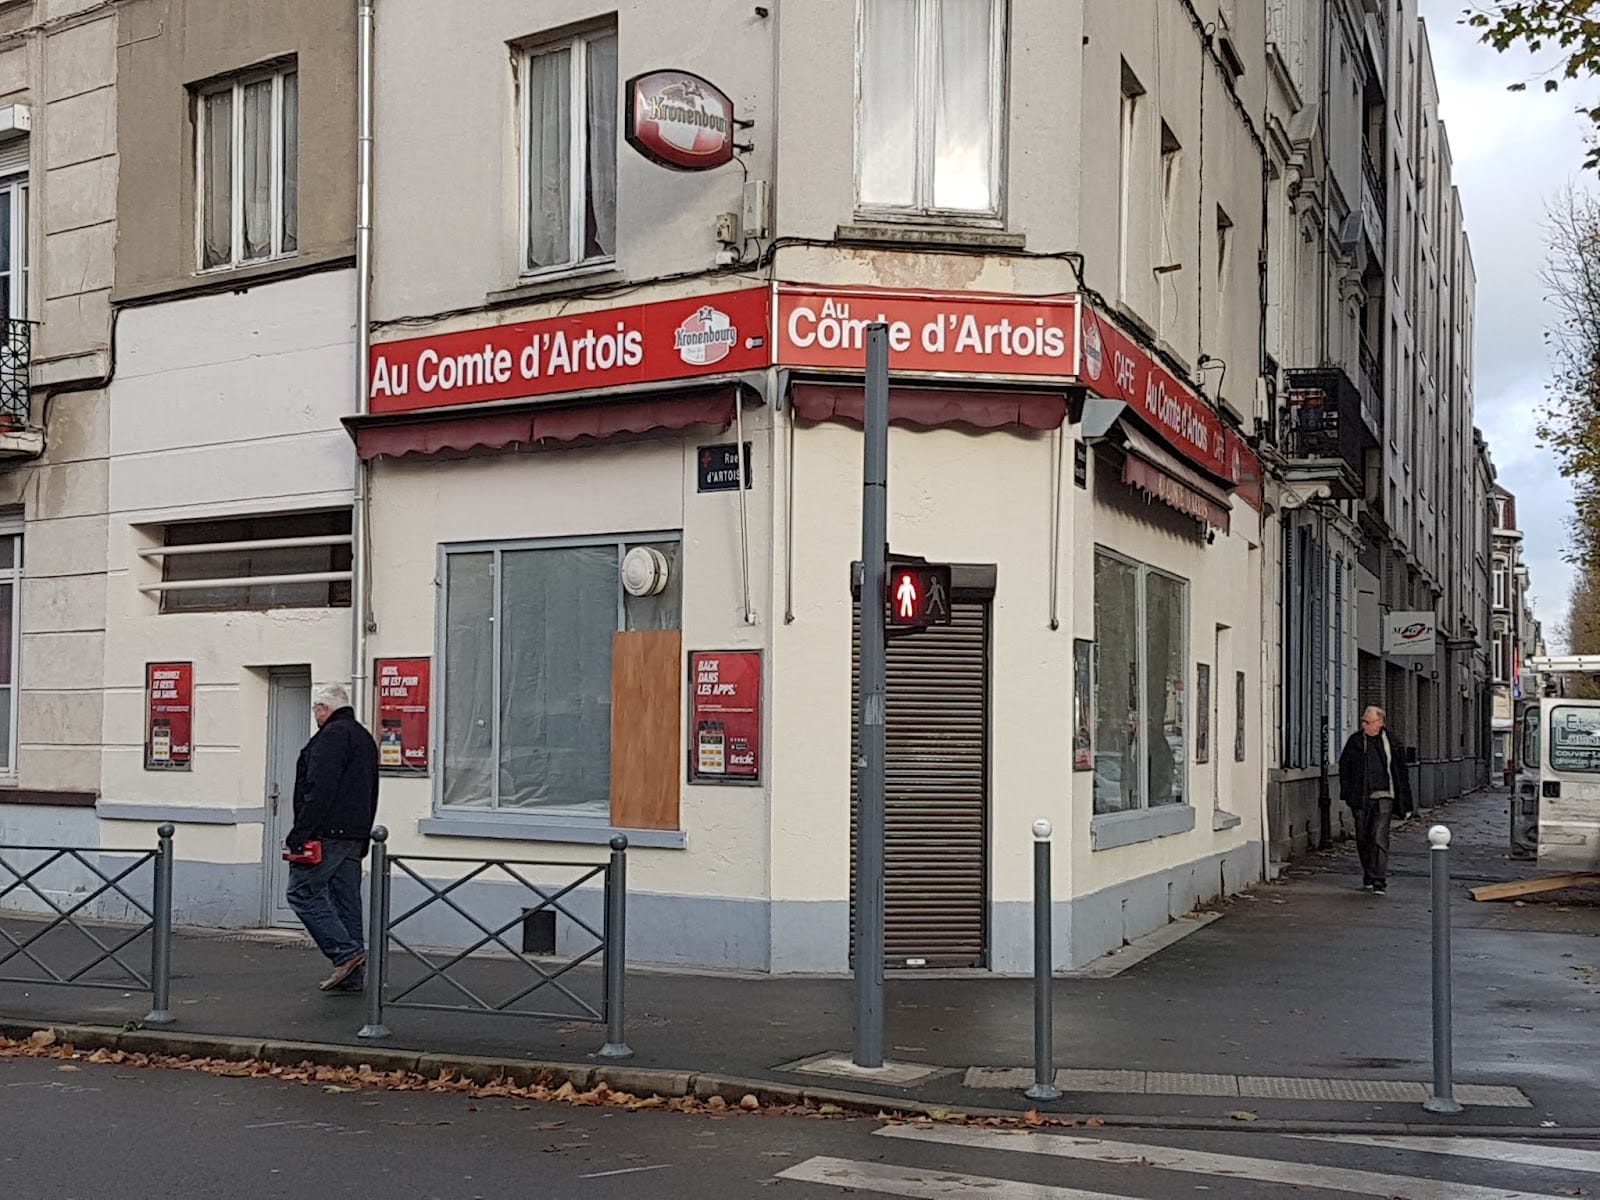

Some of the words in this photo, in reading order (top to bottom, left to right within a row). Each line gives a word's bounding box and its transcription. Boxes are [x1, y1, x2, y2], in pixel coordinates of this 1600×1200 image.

[820, 297, 849, 320] Au
[677, 325, 736, 347] Kronenbourg
[921, 313, 1065, 357] d'Artois
[370, 356, 408, 398] Au
[416, 344, 512, 392] Comte
[520, 322, 643, 380] d'Artois
[1114, 350, 1136, 395] CAFE
[1145, 371, 1157, 415] Au
[1157, 381, 1181, 434] Comte
[724, 452, 739, 464] Rue
[698, 660, 719, 671] BACK
[697, 684, 711, 695] LES
